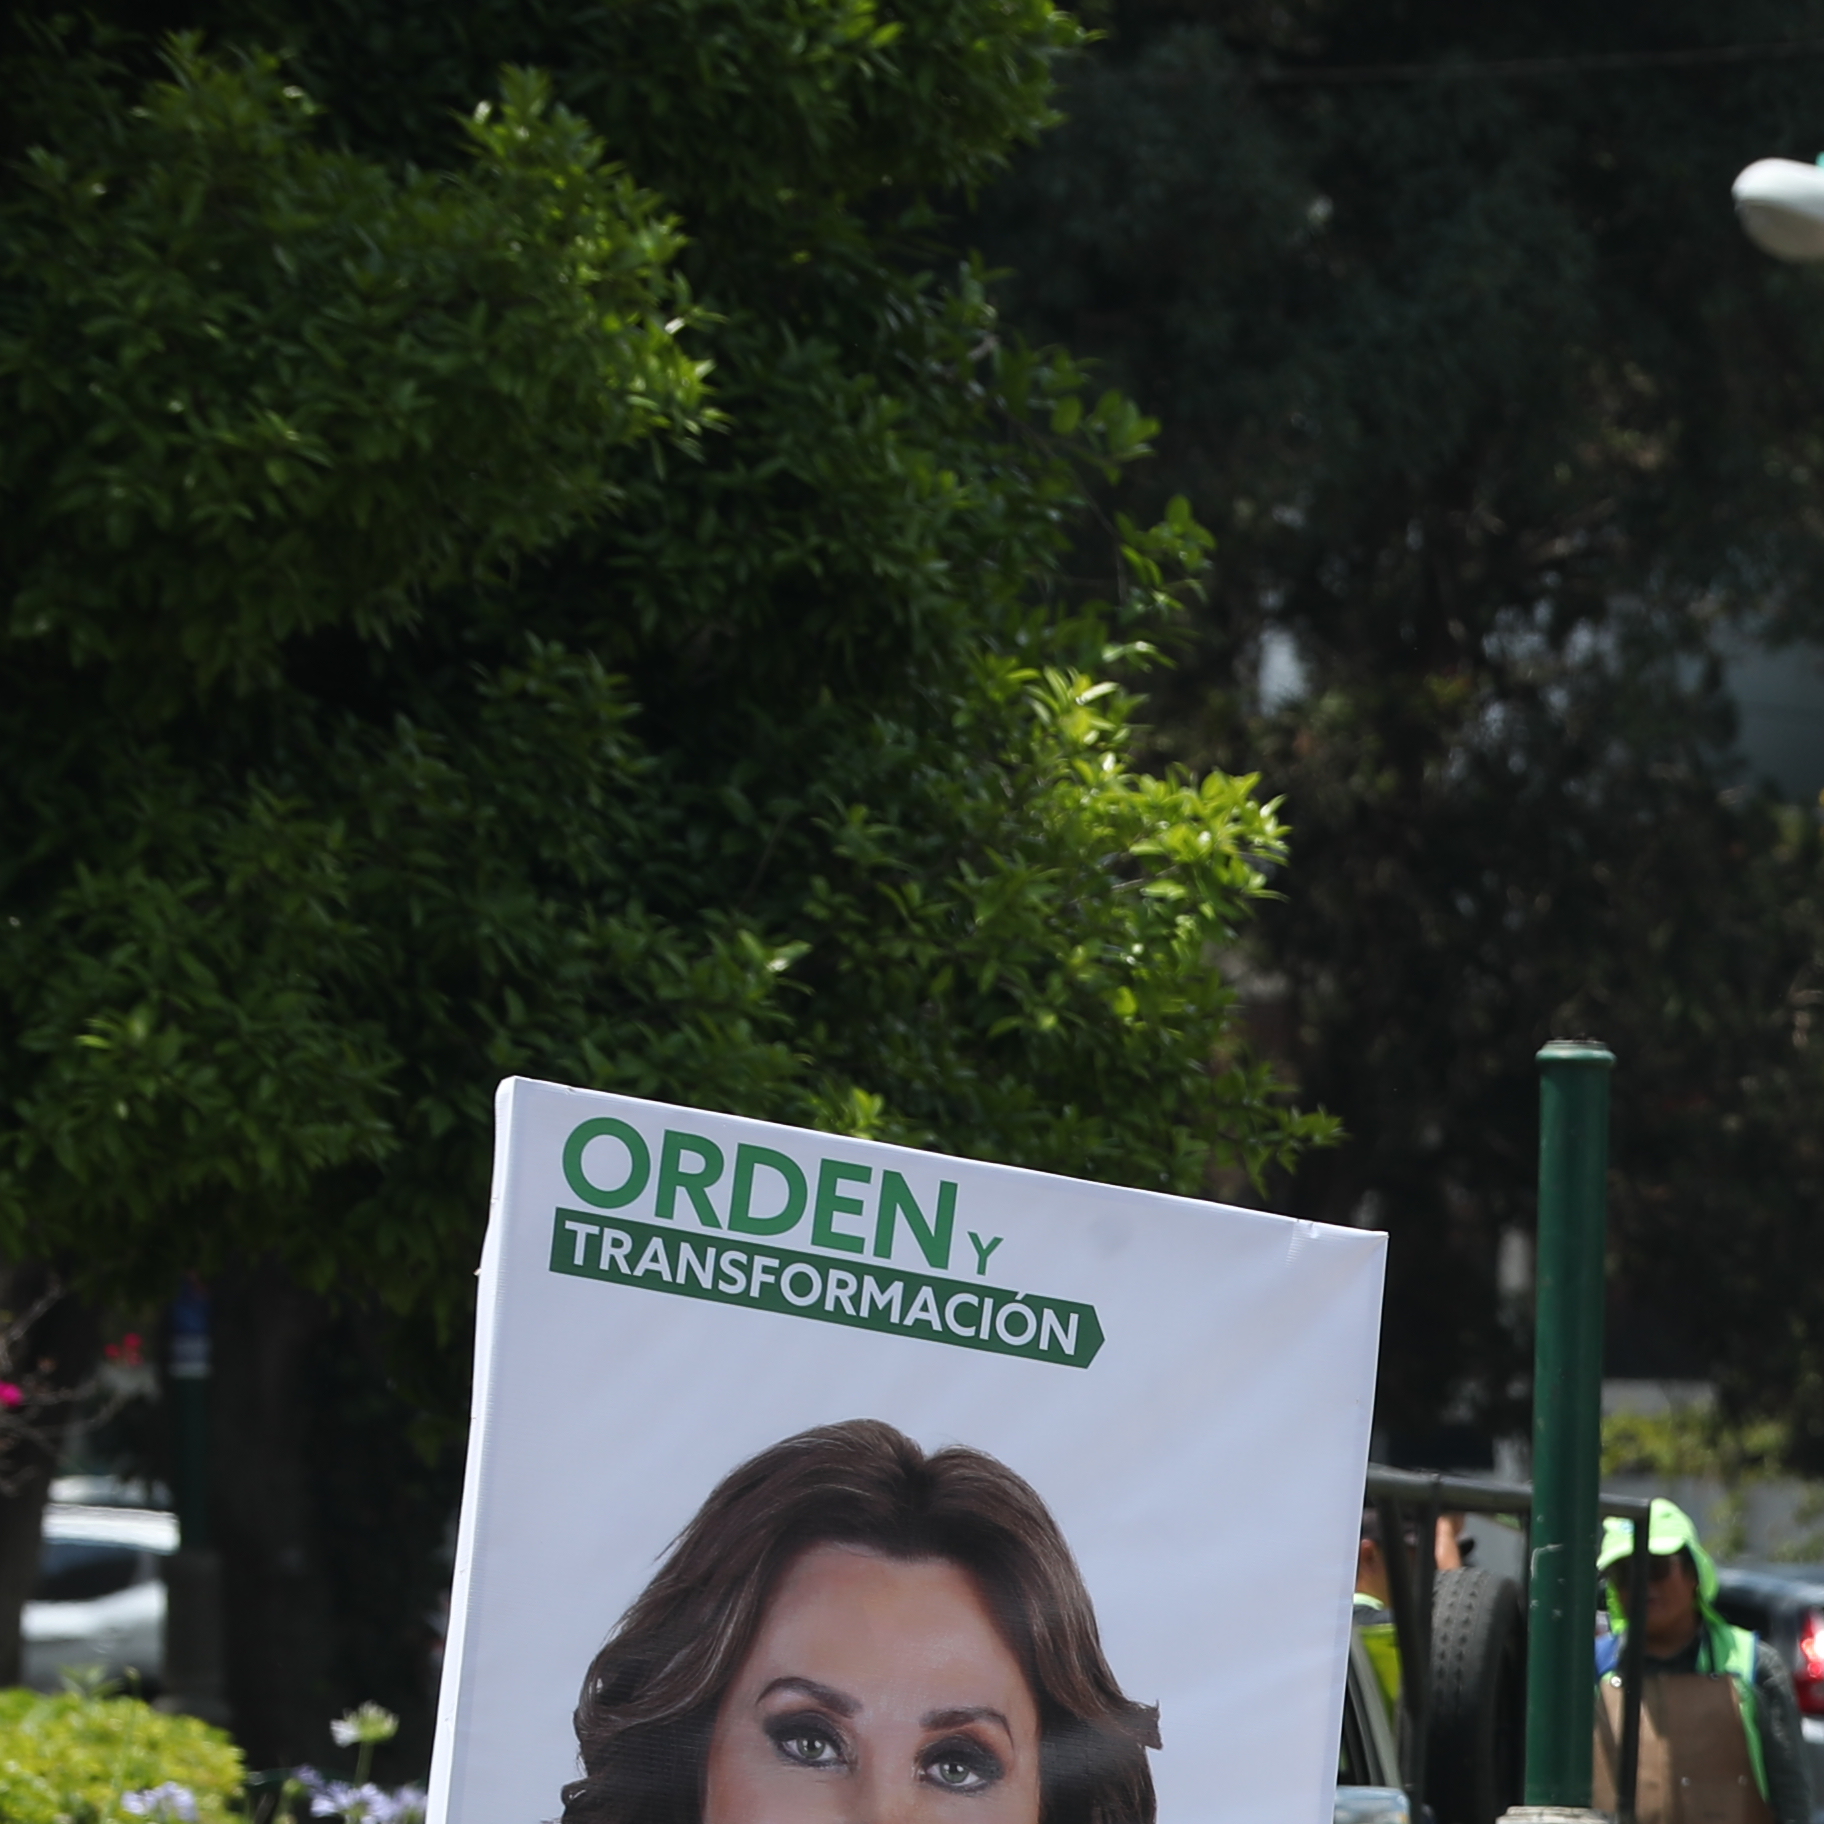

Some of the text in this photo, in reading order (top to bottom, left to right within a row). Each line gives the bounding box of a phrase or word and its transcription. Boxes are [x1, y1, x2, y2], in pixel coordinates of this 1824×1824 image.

[562, 1116, 1004, 1276] ORDEN Y
[564, 1219, 1080, 1356] TRANSFORMACIÓN
